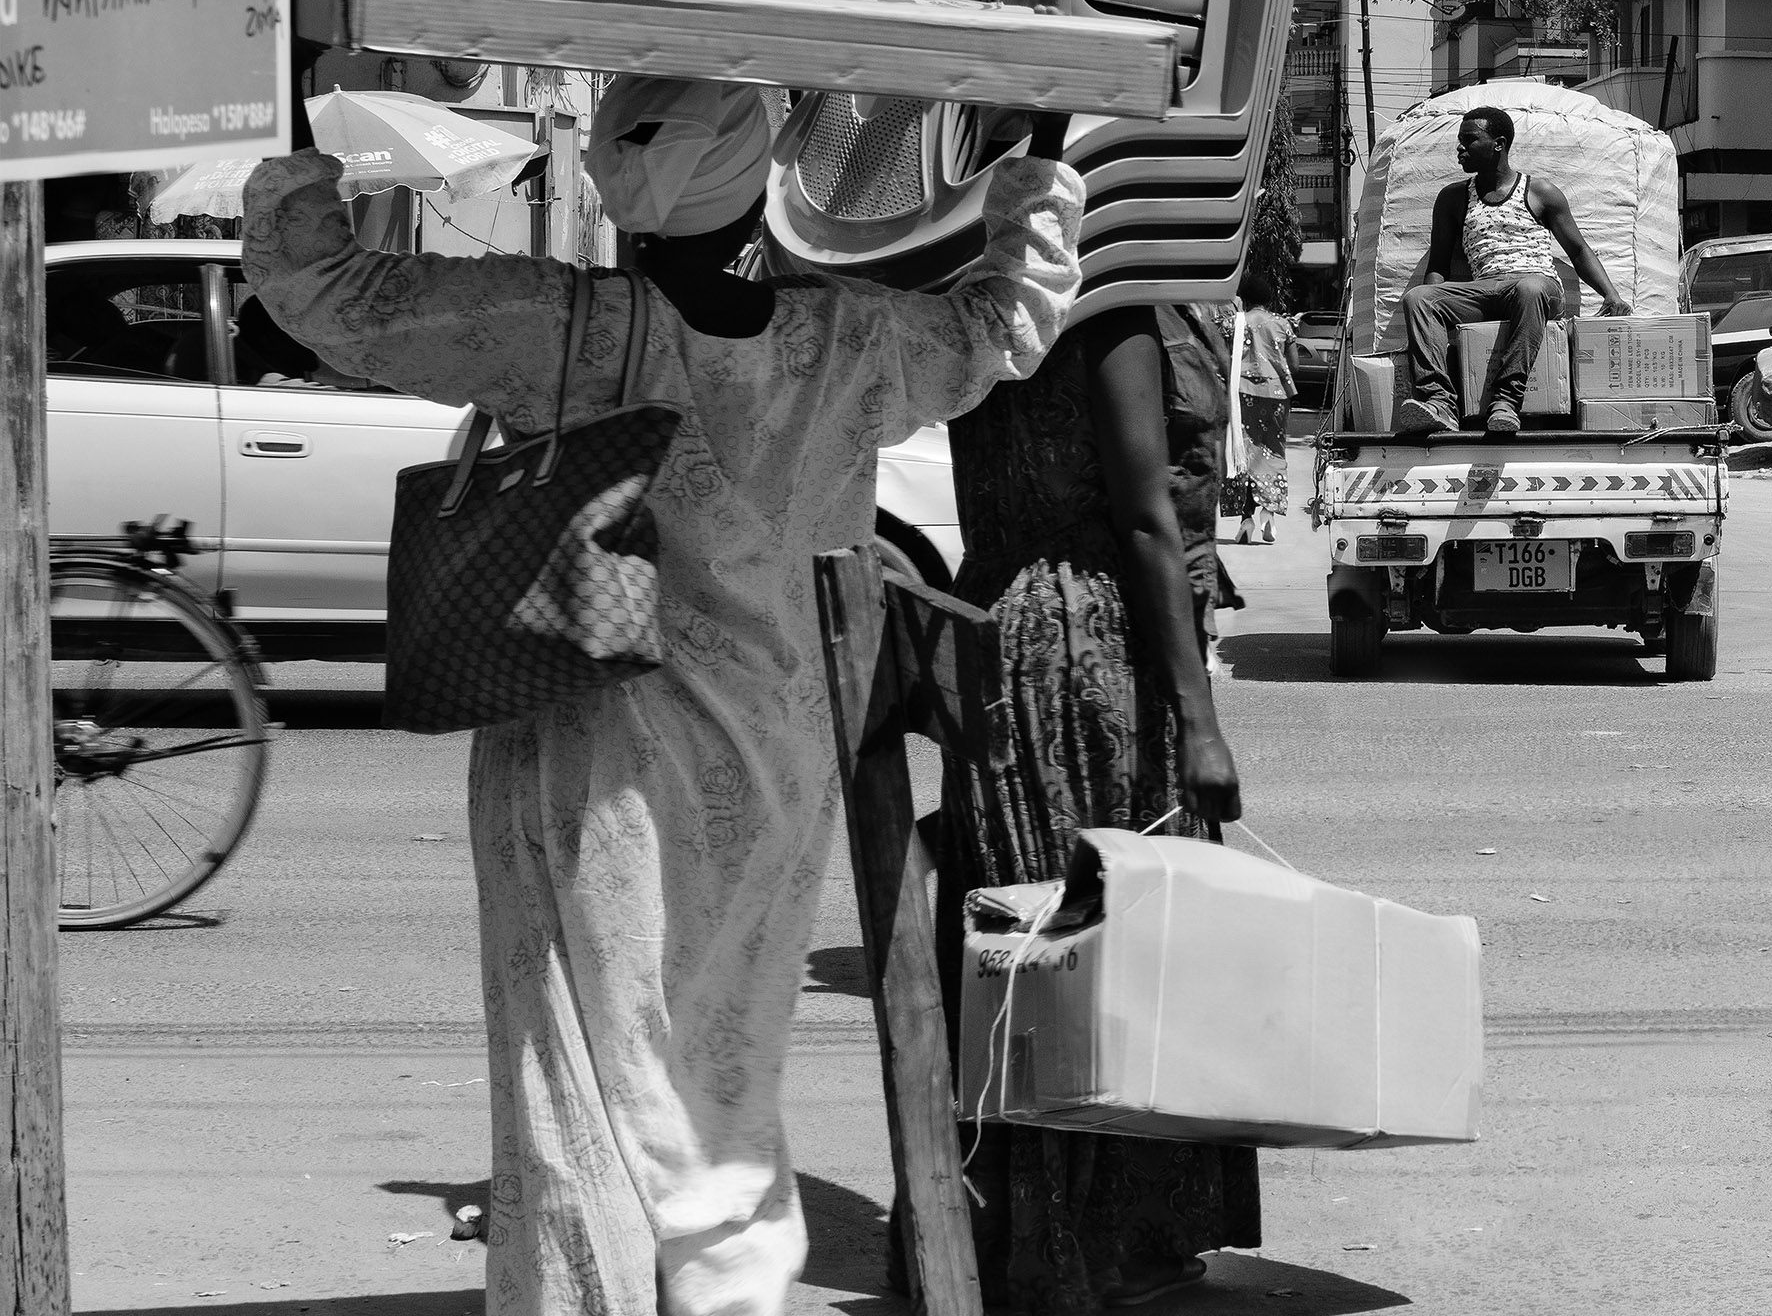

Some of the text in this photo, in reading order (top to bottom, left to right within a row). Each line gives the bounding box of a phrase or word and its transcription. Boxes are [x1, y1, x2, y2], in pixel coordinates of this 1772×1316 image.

[452, 139, 502, 158] DIGITAL
[454, 147, 500, 165] WORLD
[1495, 542, 1545, 564] T166
[1508, 566, 1546, 588] DGB
